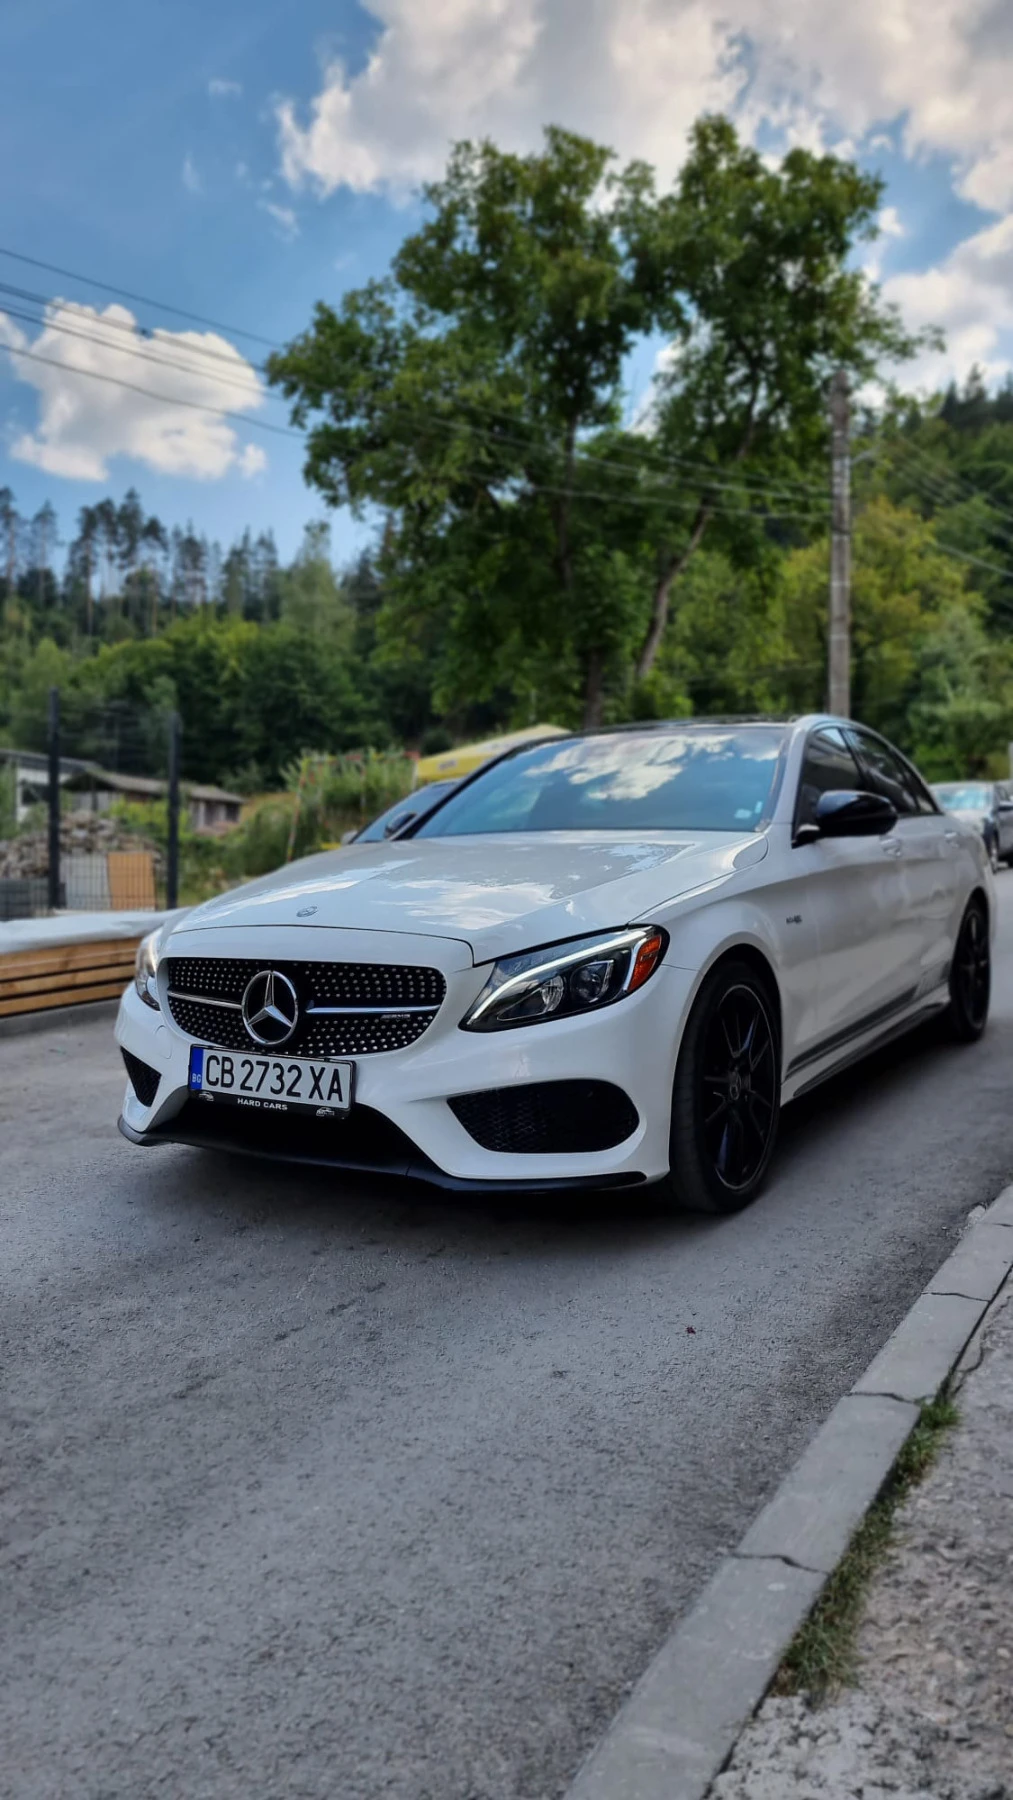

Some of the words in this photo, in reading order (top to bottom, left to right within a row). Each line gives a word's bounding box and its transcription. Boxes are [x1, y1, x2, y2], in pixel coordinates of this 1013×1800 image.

[191, 1073, 202, 1083] BG
[206, 1055, 235, 1088] CB
[240, 1059, 302, 1098] 2732
[308, 1065, 343, 1102] XA
[237, 1098, 261, 1108] HARD
[263, 1101, 288, 1111] CARS
